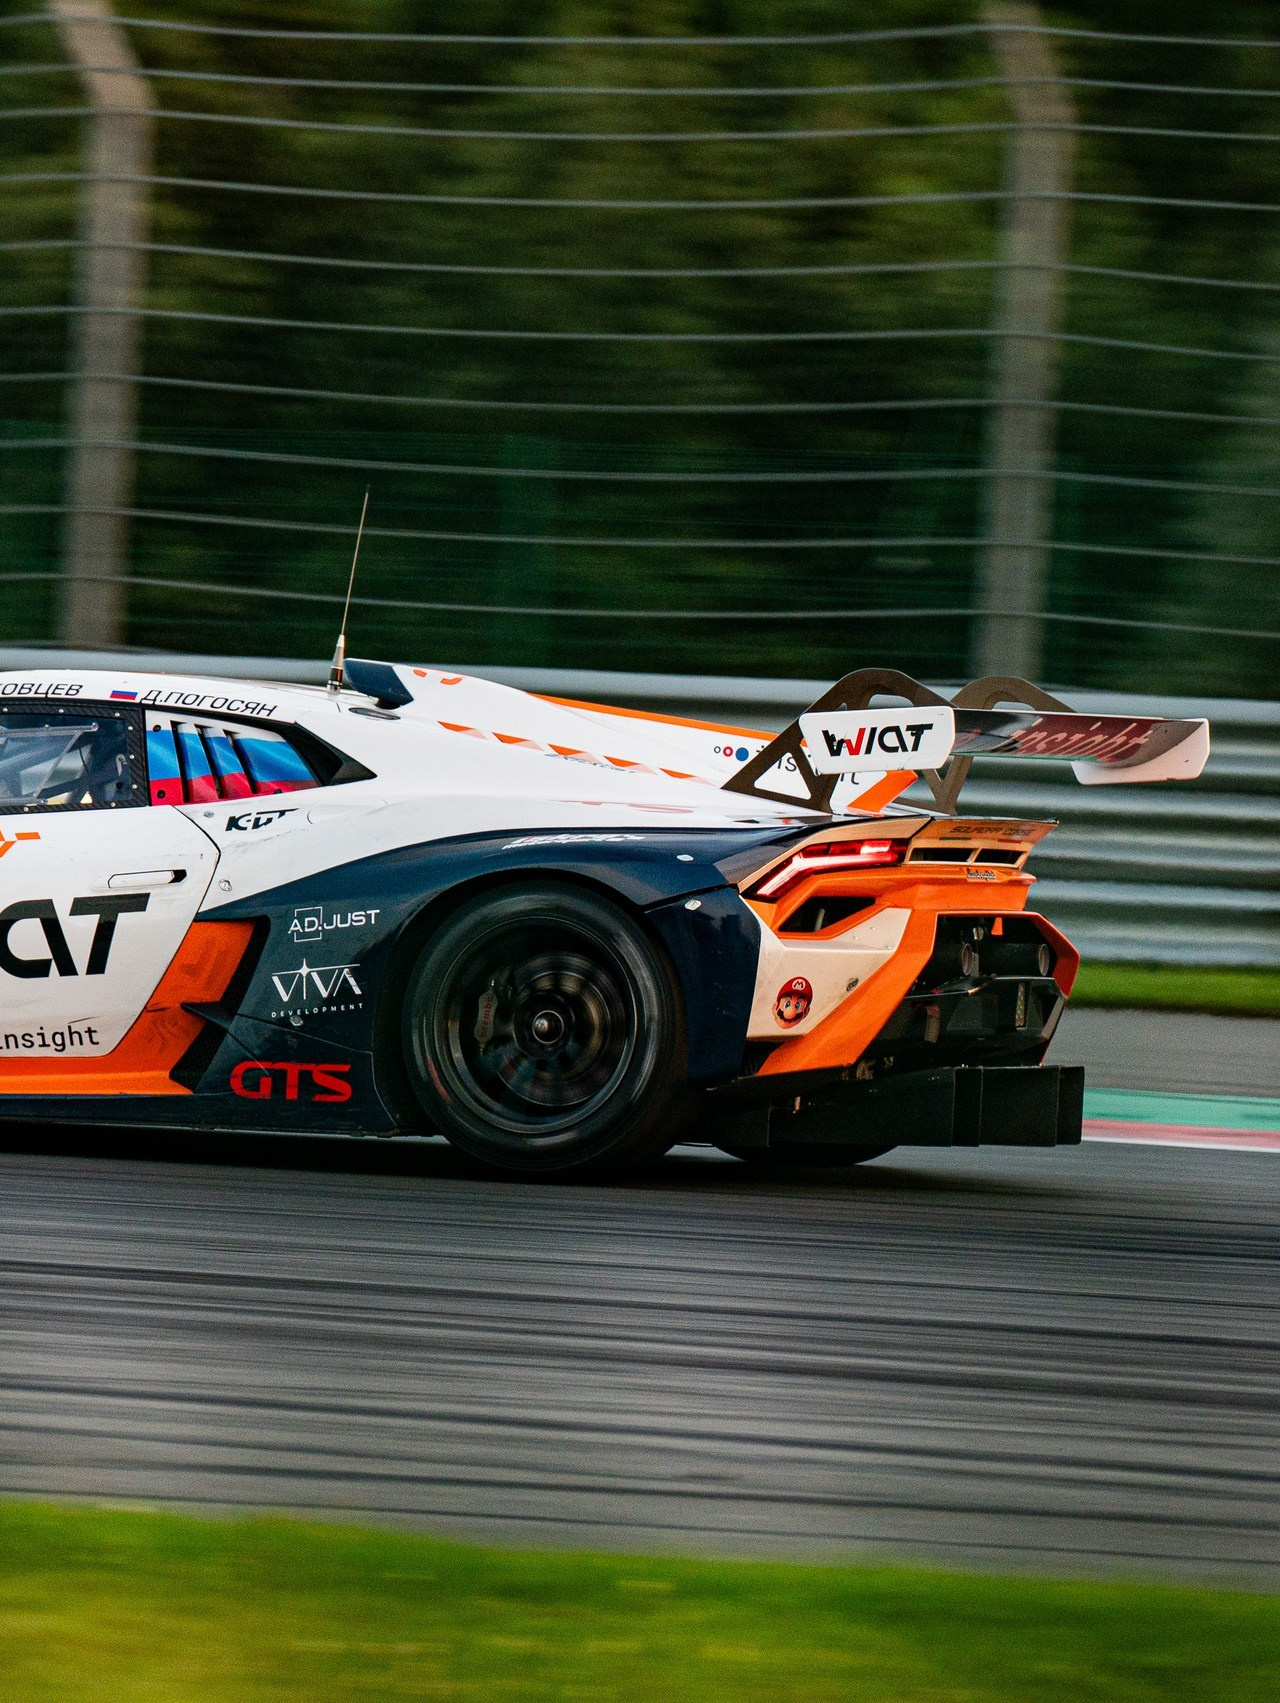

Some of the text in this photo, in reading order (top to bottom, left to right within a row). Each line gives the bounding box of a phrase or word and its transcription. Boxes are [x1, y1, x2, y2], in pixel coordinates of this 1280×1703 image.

[271, 958, 363, 1002] VIVA
[271, 1003, 363, 1018] DEVELOPMENT
[229, 1061, 352, 1103] GTS
